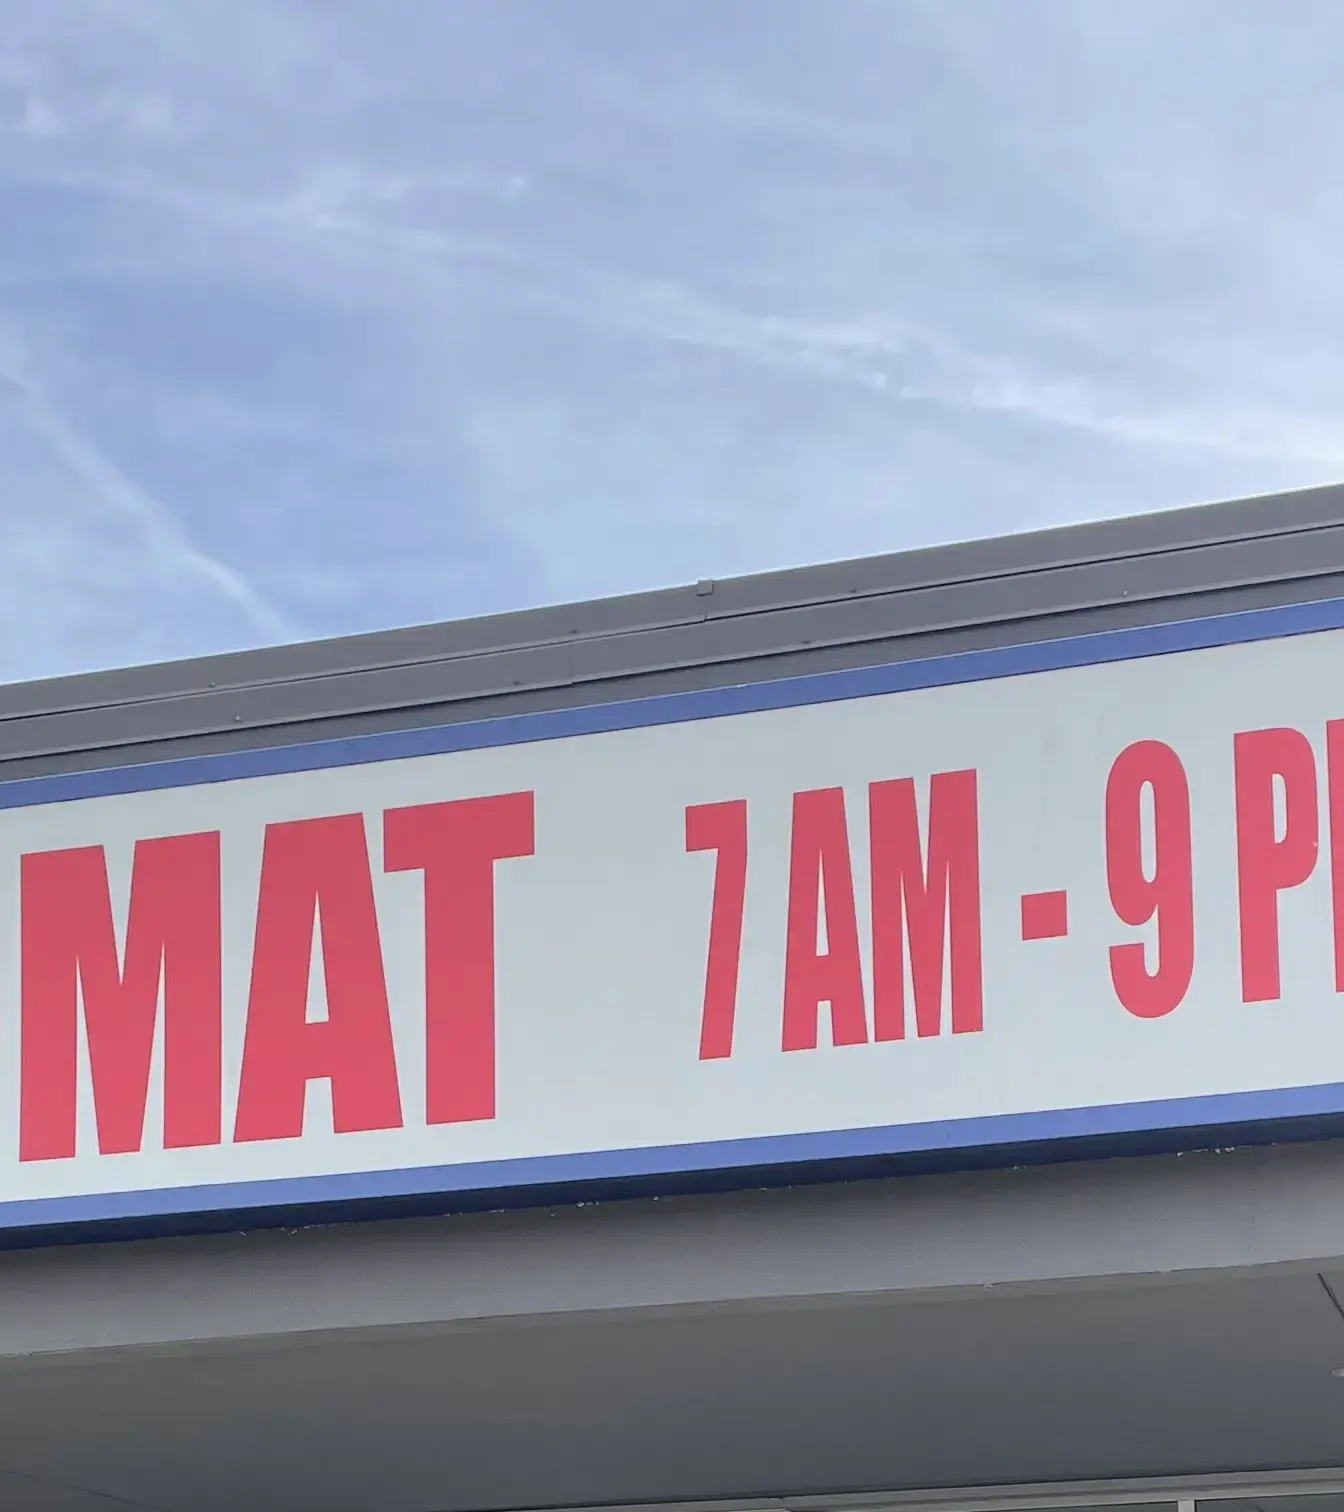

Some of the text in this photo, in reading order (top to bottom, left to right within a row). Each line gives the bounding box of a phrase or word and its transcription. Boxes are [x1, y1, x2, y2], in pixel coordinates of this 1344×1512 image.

[685, 799, 747, 1060] 7
[782, 768, 983, 1051] AM
[1106, 740, 1194, 1018] 9
